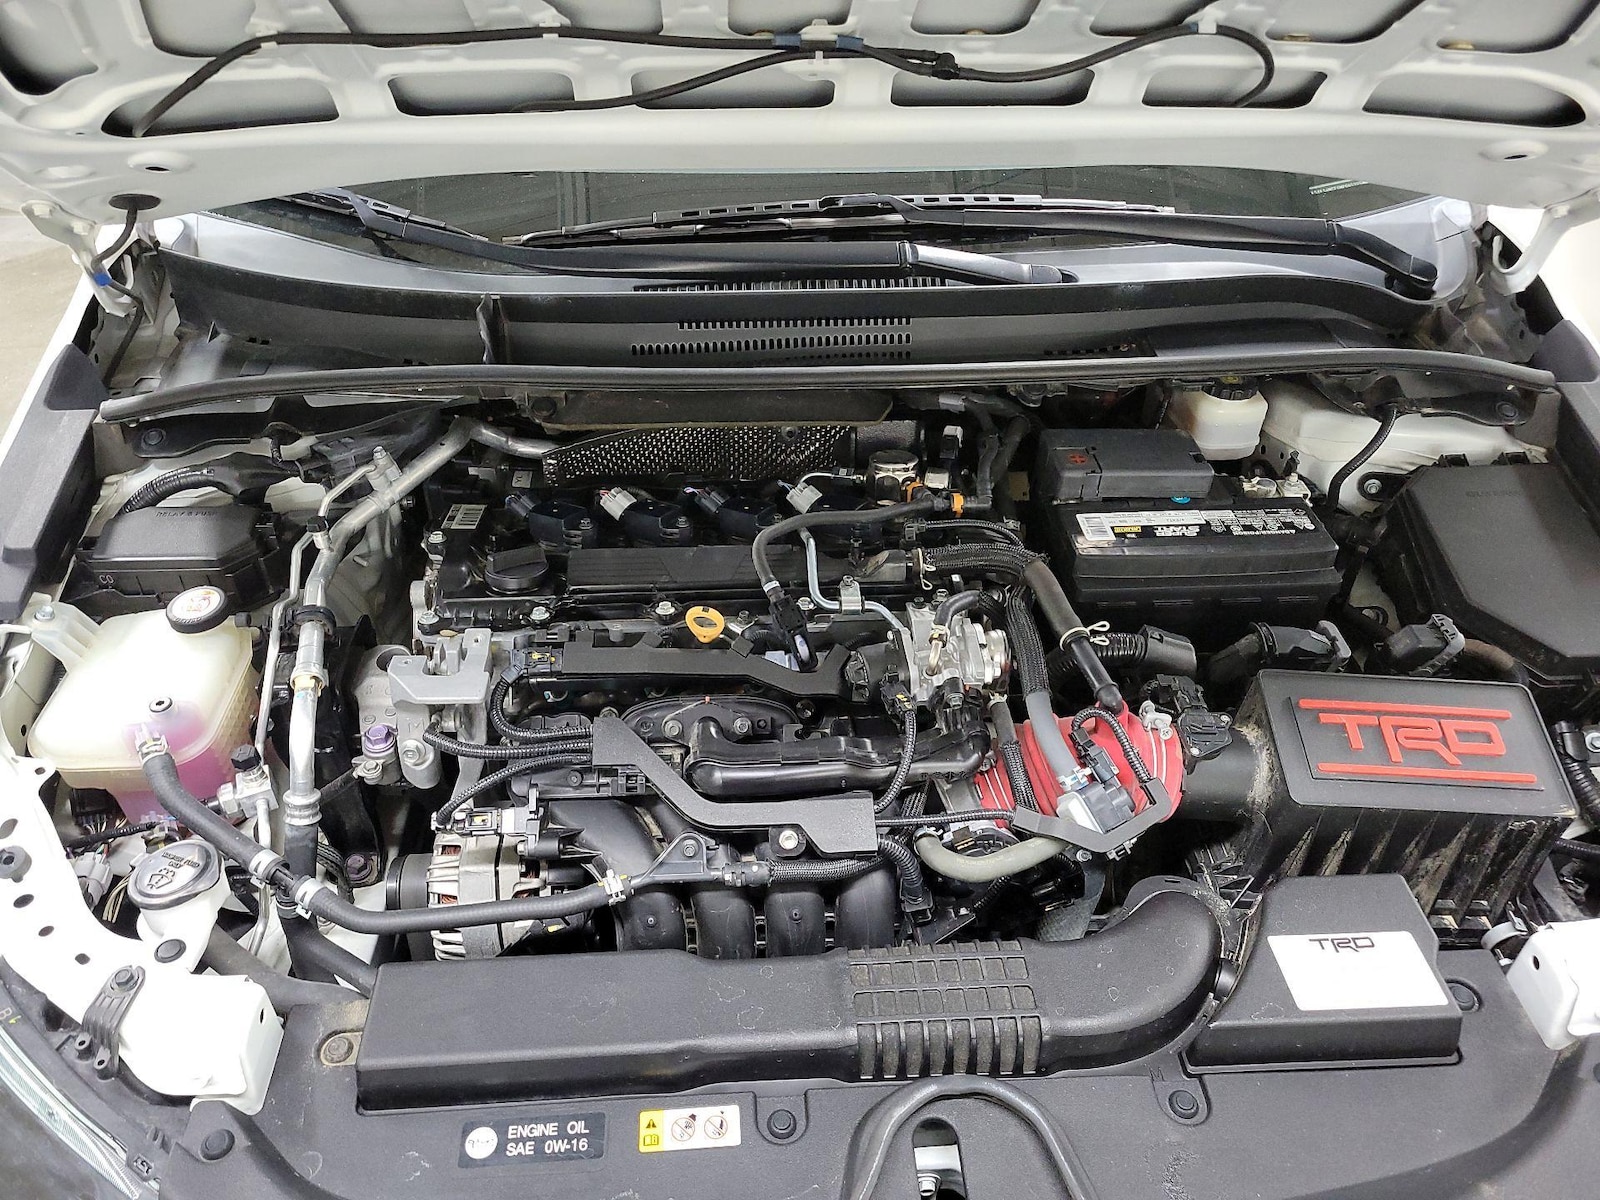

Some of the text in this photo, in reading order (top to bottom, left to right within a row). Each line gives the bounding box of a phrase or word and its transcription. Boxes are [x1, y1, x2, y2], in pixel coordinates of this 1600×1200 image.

[1153, 525, 1200, 533] START
[1318, 713, 1506, 766] TRD
[1308, 936, 1375, 953] TRD
[507, 1120, 590, 1139] ENGINE OIL
[506, 1141, 536, 1157] SAE
[544, 1138, 589, 1154] 0W-16
